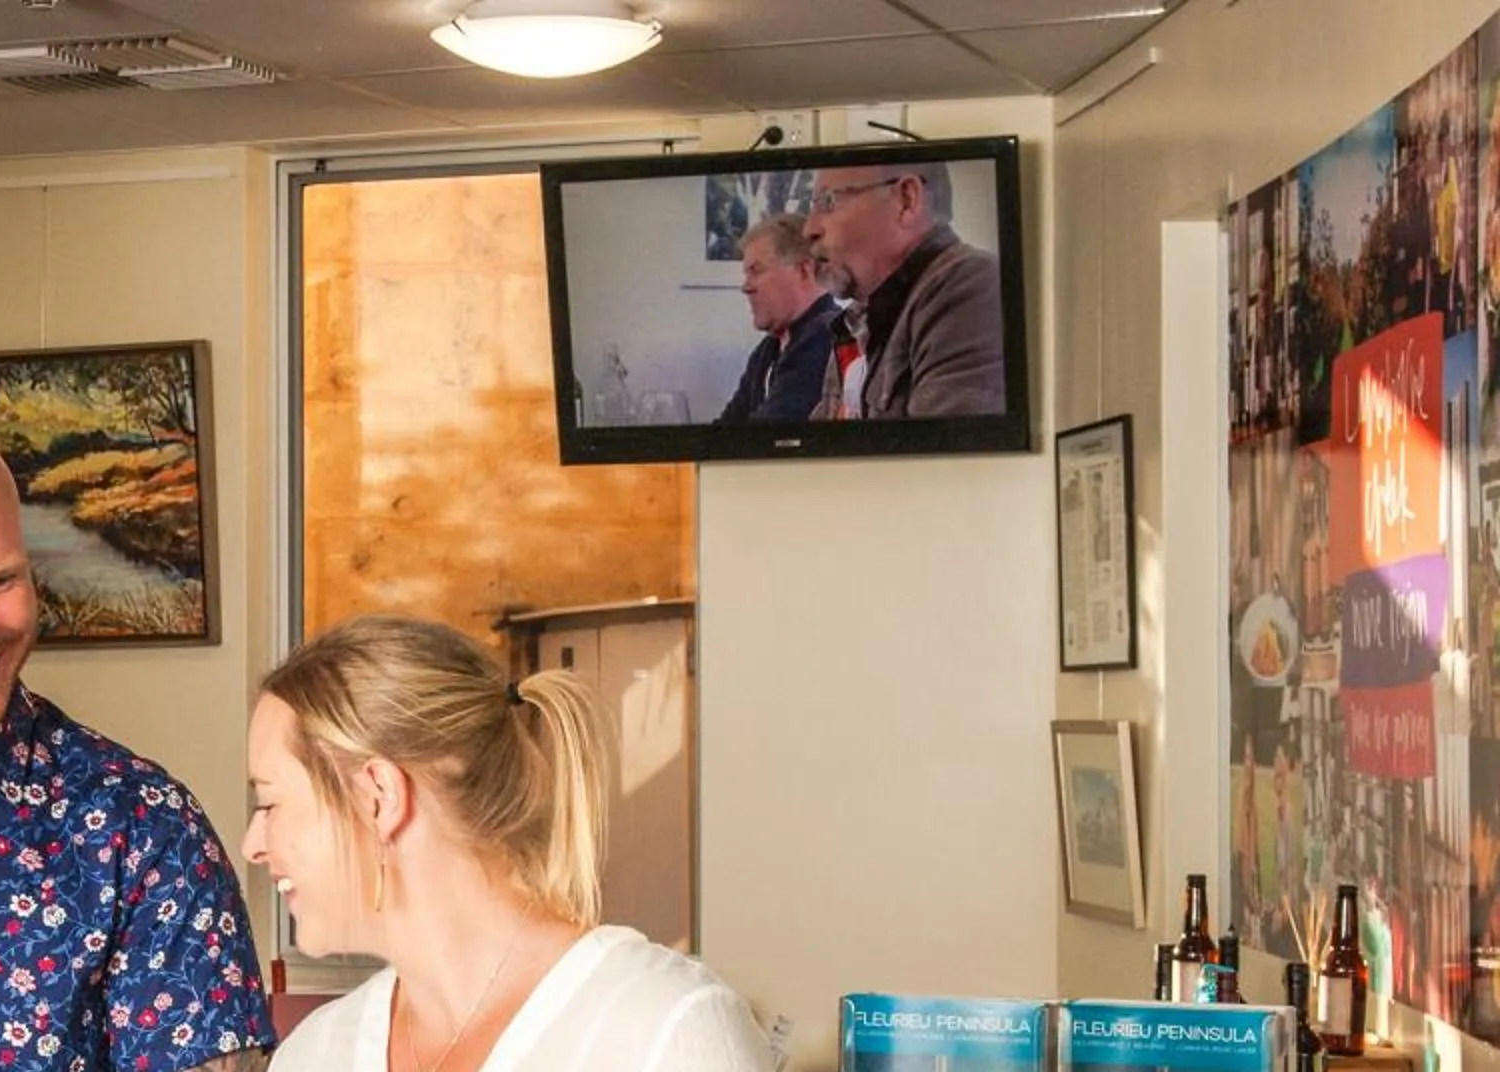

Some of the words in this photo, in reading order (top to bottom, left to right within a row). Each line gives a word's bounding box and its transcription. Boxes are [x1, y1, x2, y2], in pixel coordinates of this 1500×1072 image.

[855, 1011, 931, 1029] FLEURIEU
[936, 1015, 1032, 1034] PENINSULA
[1073, 1021, 1152, 1039] FLEURIEU
[1156, 1023, 1258, 1044] PENINSULA
